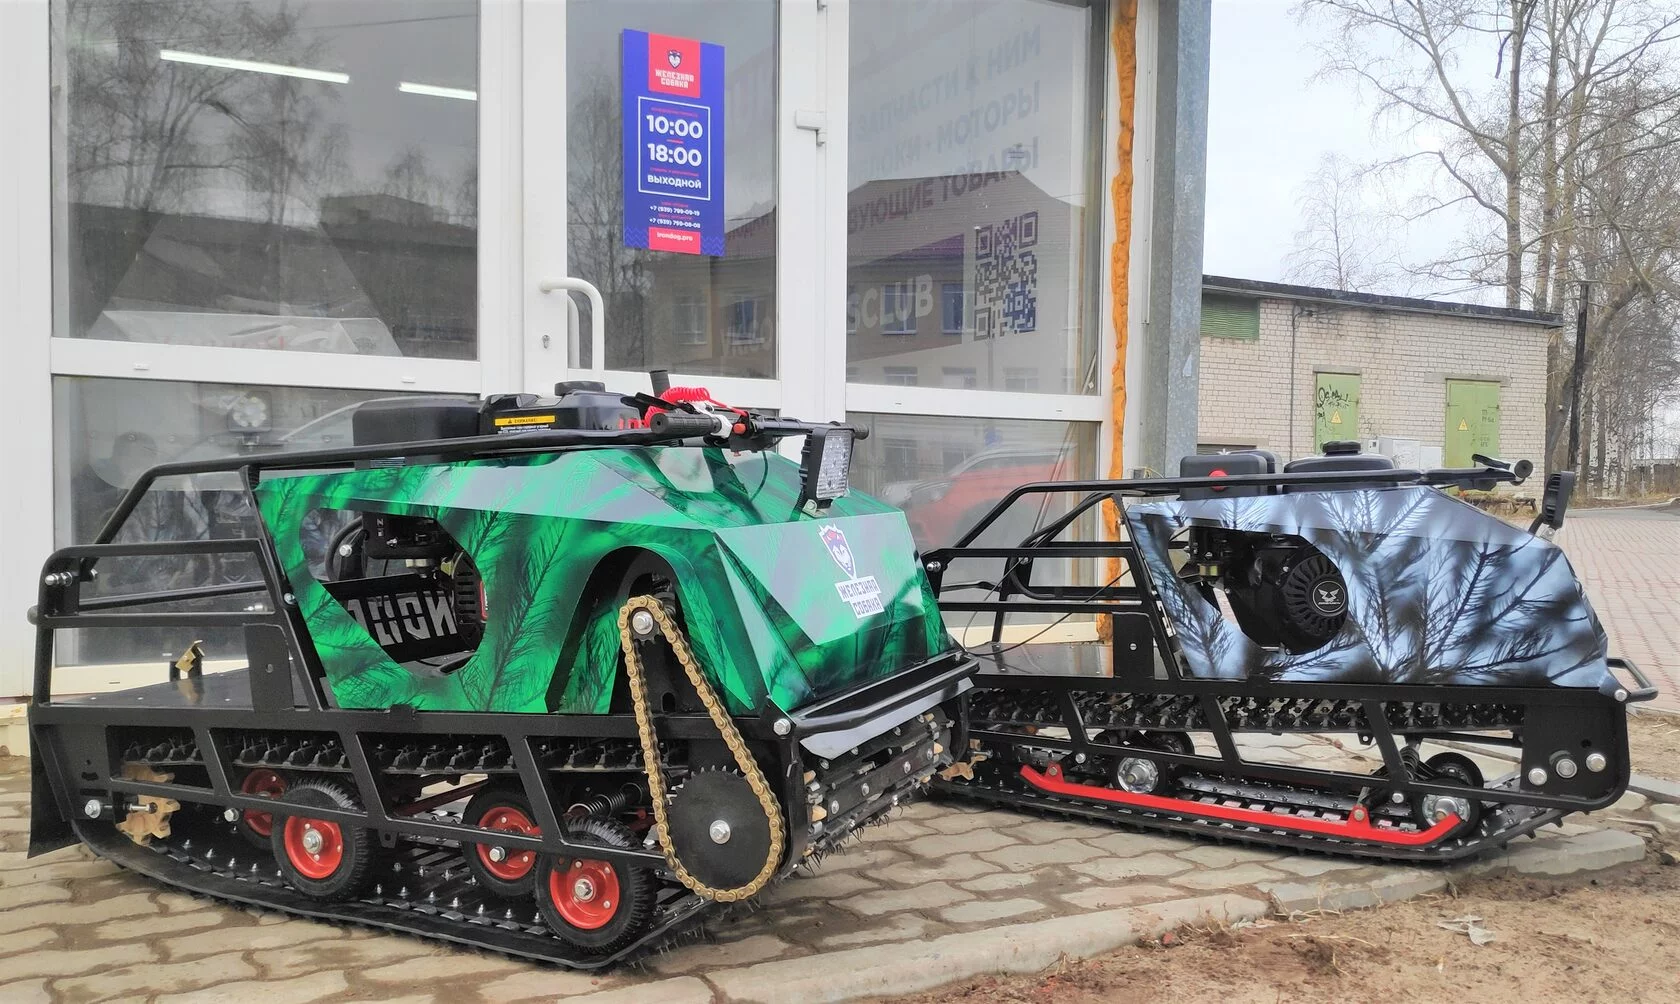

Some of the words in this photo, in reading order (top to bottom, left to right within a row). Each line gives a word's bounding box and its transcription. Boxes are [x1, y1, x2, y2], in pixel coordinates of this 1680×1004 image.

[655, 69, 694, 82] ЖЕЛЕЗНАЯ
[661, 77, 689, 89] СОБАКА
[646, 115, 703, 139] 10:00
[937, 80, 1040, 154] МОТОРЫ
[647, 143, 702, 167] 18:00
[940, 136, 1039, 202] ТОВАРЫ
[647, 174, 702, 189] ВЫХОДНОЙ
[839, 579, 880, 599] ЖЕЛЕЗНАЯ
[852, 598, 882, 615] СОБАКА
